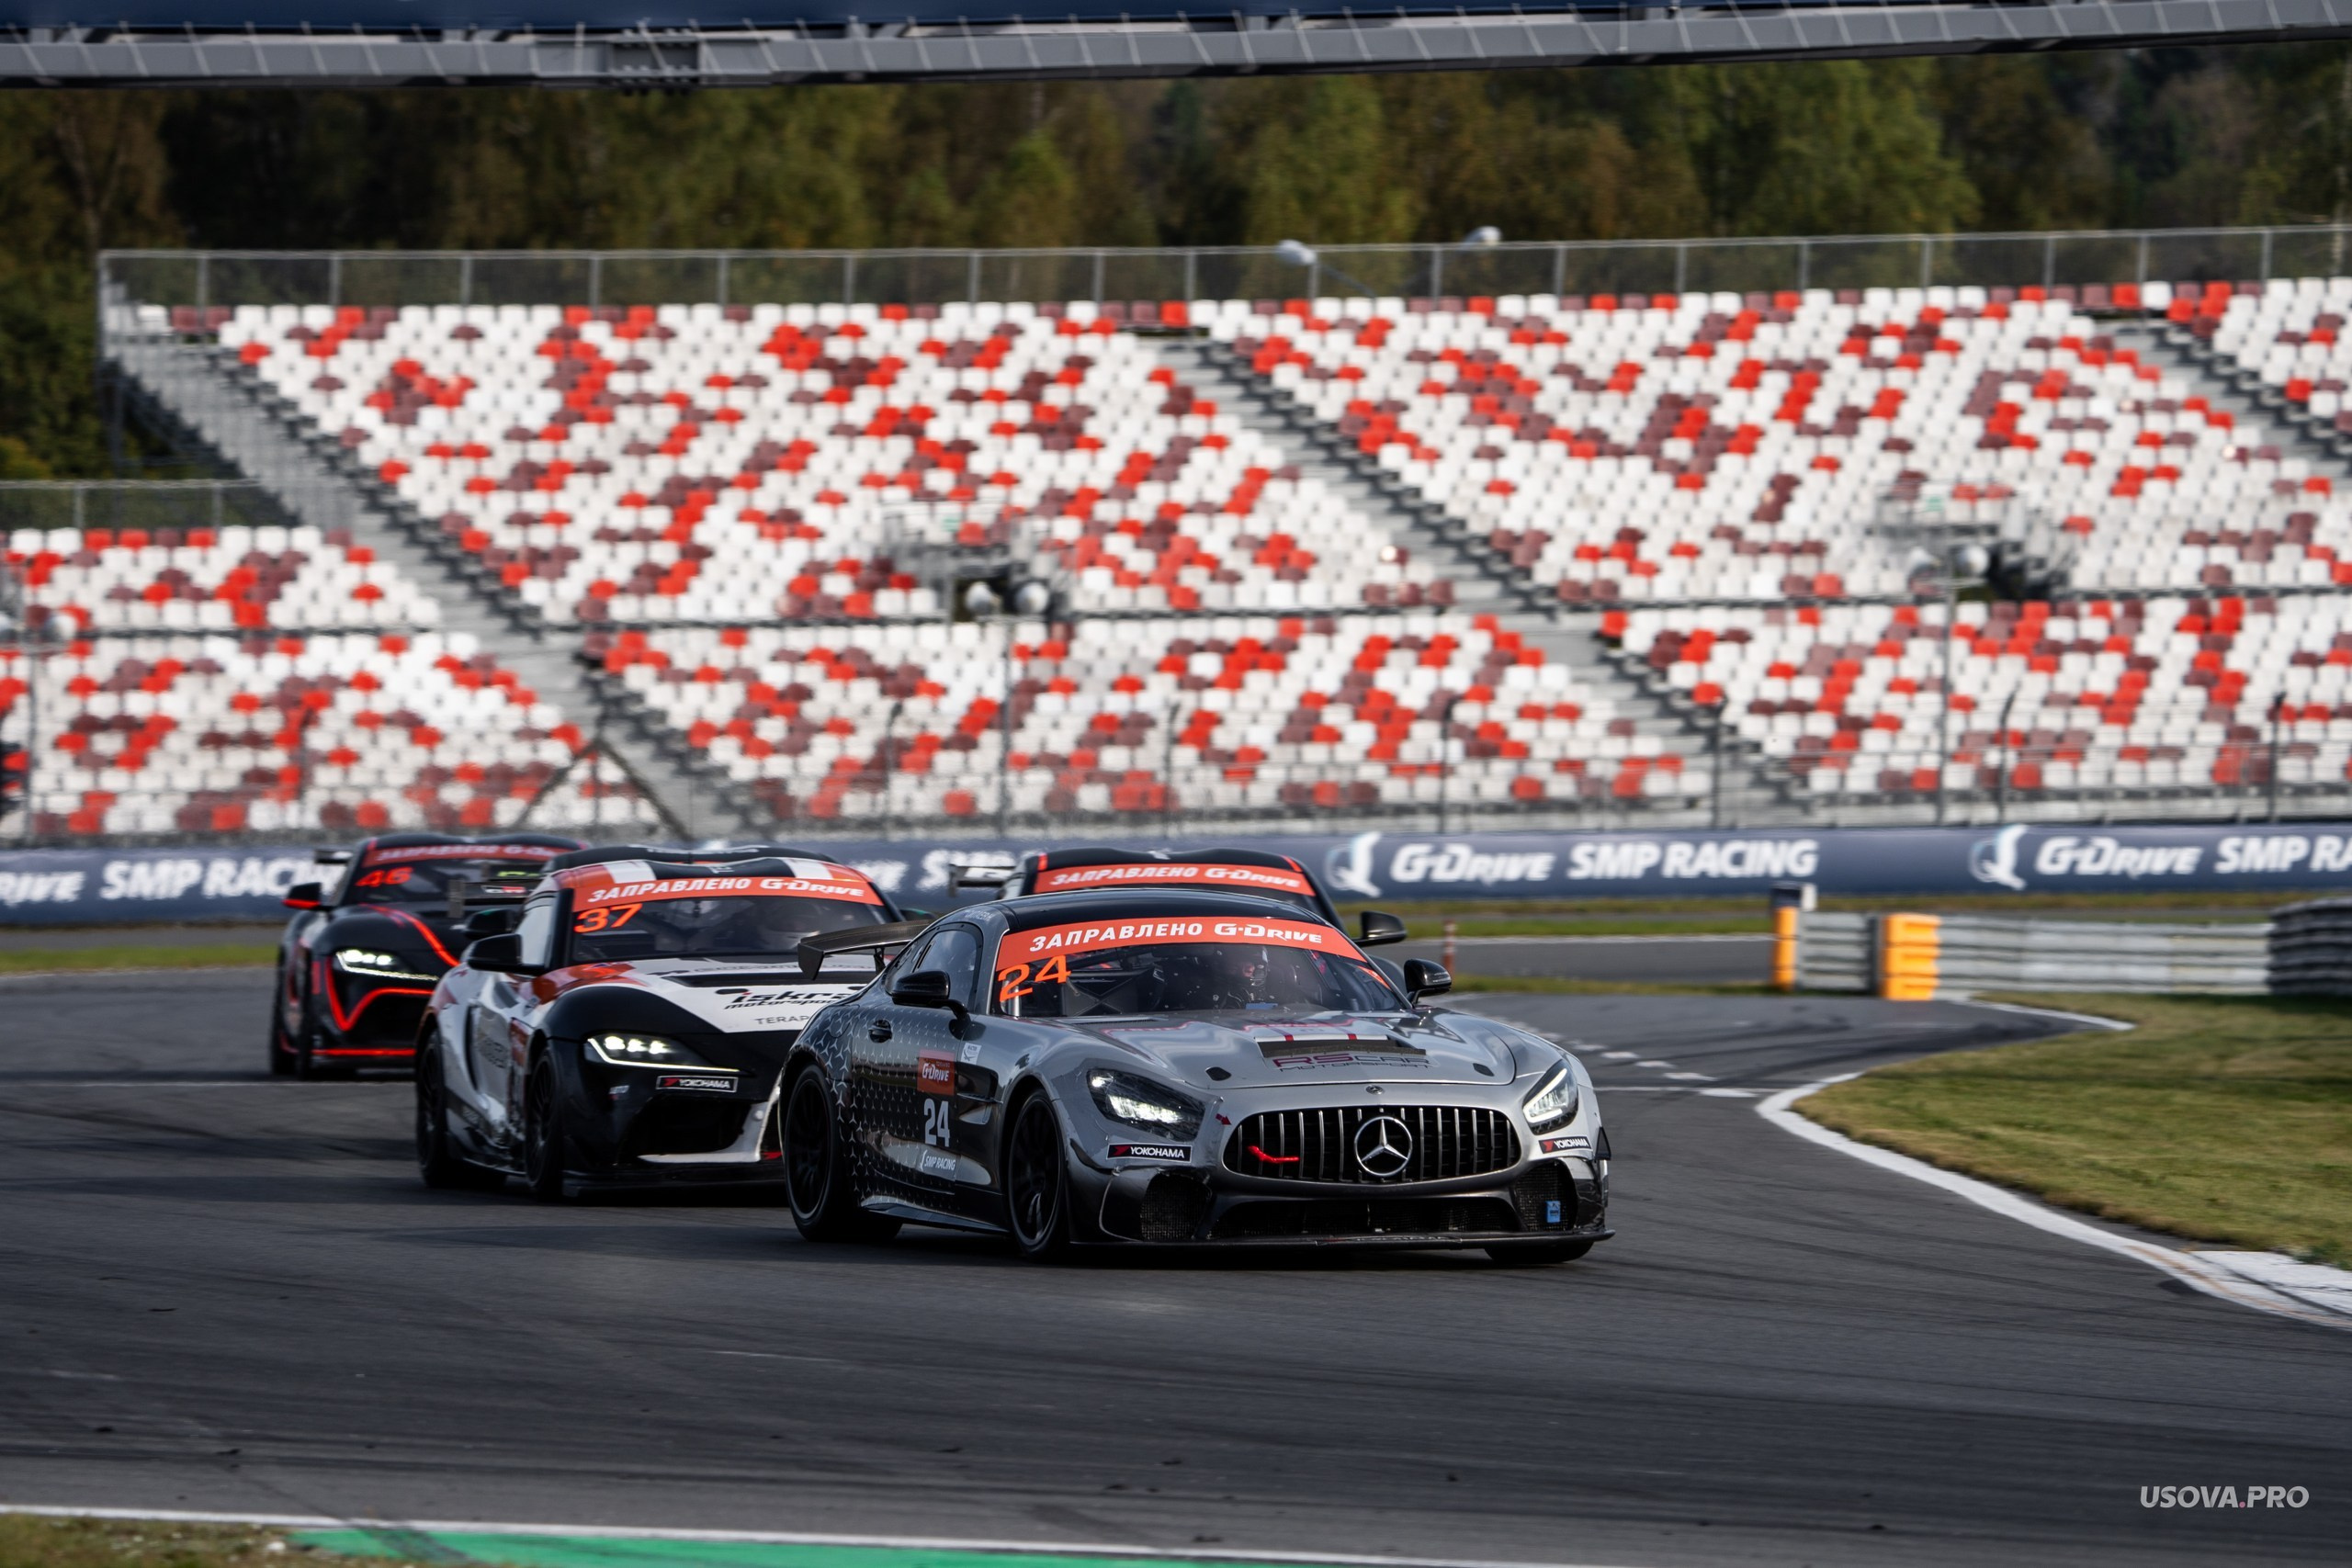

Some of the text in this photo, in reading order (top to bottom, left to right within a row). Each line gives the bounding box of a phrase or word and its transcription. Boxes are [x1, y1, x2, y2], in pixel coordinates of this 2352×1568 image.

[1566, 841, 1661, 880] SMP
[1662, 839, 1820, 879] RACING
[2214, 835, 2311, 874] SMP
[99, 859, 203, 900] SMP
[356, 867, 413, 887] 46
[1049, 866, 1198, 886] ЗАПРАВЛЕНО
[587, 877, 751, 903] ЗАПРАВЛЕНО
[572, 903, 643, 934] 37
[1029, 922, 1204, 953] ЗАПРАВЛЕНО
[997, 954, 1072, 1003] 24
[723, 998, 836, 1010] motorspor
[754, 1015, 811, 1025] TERAP
[1272, 1053, 1430, 1068] RSCAR
[1280, 1062, 1432, 1073] MOTORSPORT
[679, 1078, 731, 1089] YOKOHAMA
[923, 1098, 951, 1148] 24
[1129, 1145, 1185, 1158] YOKOHAMA
[1554, 1137, 1589, 1149] YOKOHAMA
[924, 1155, 956, 1171] SMP RACING
